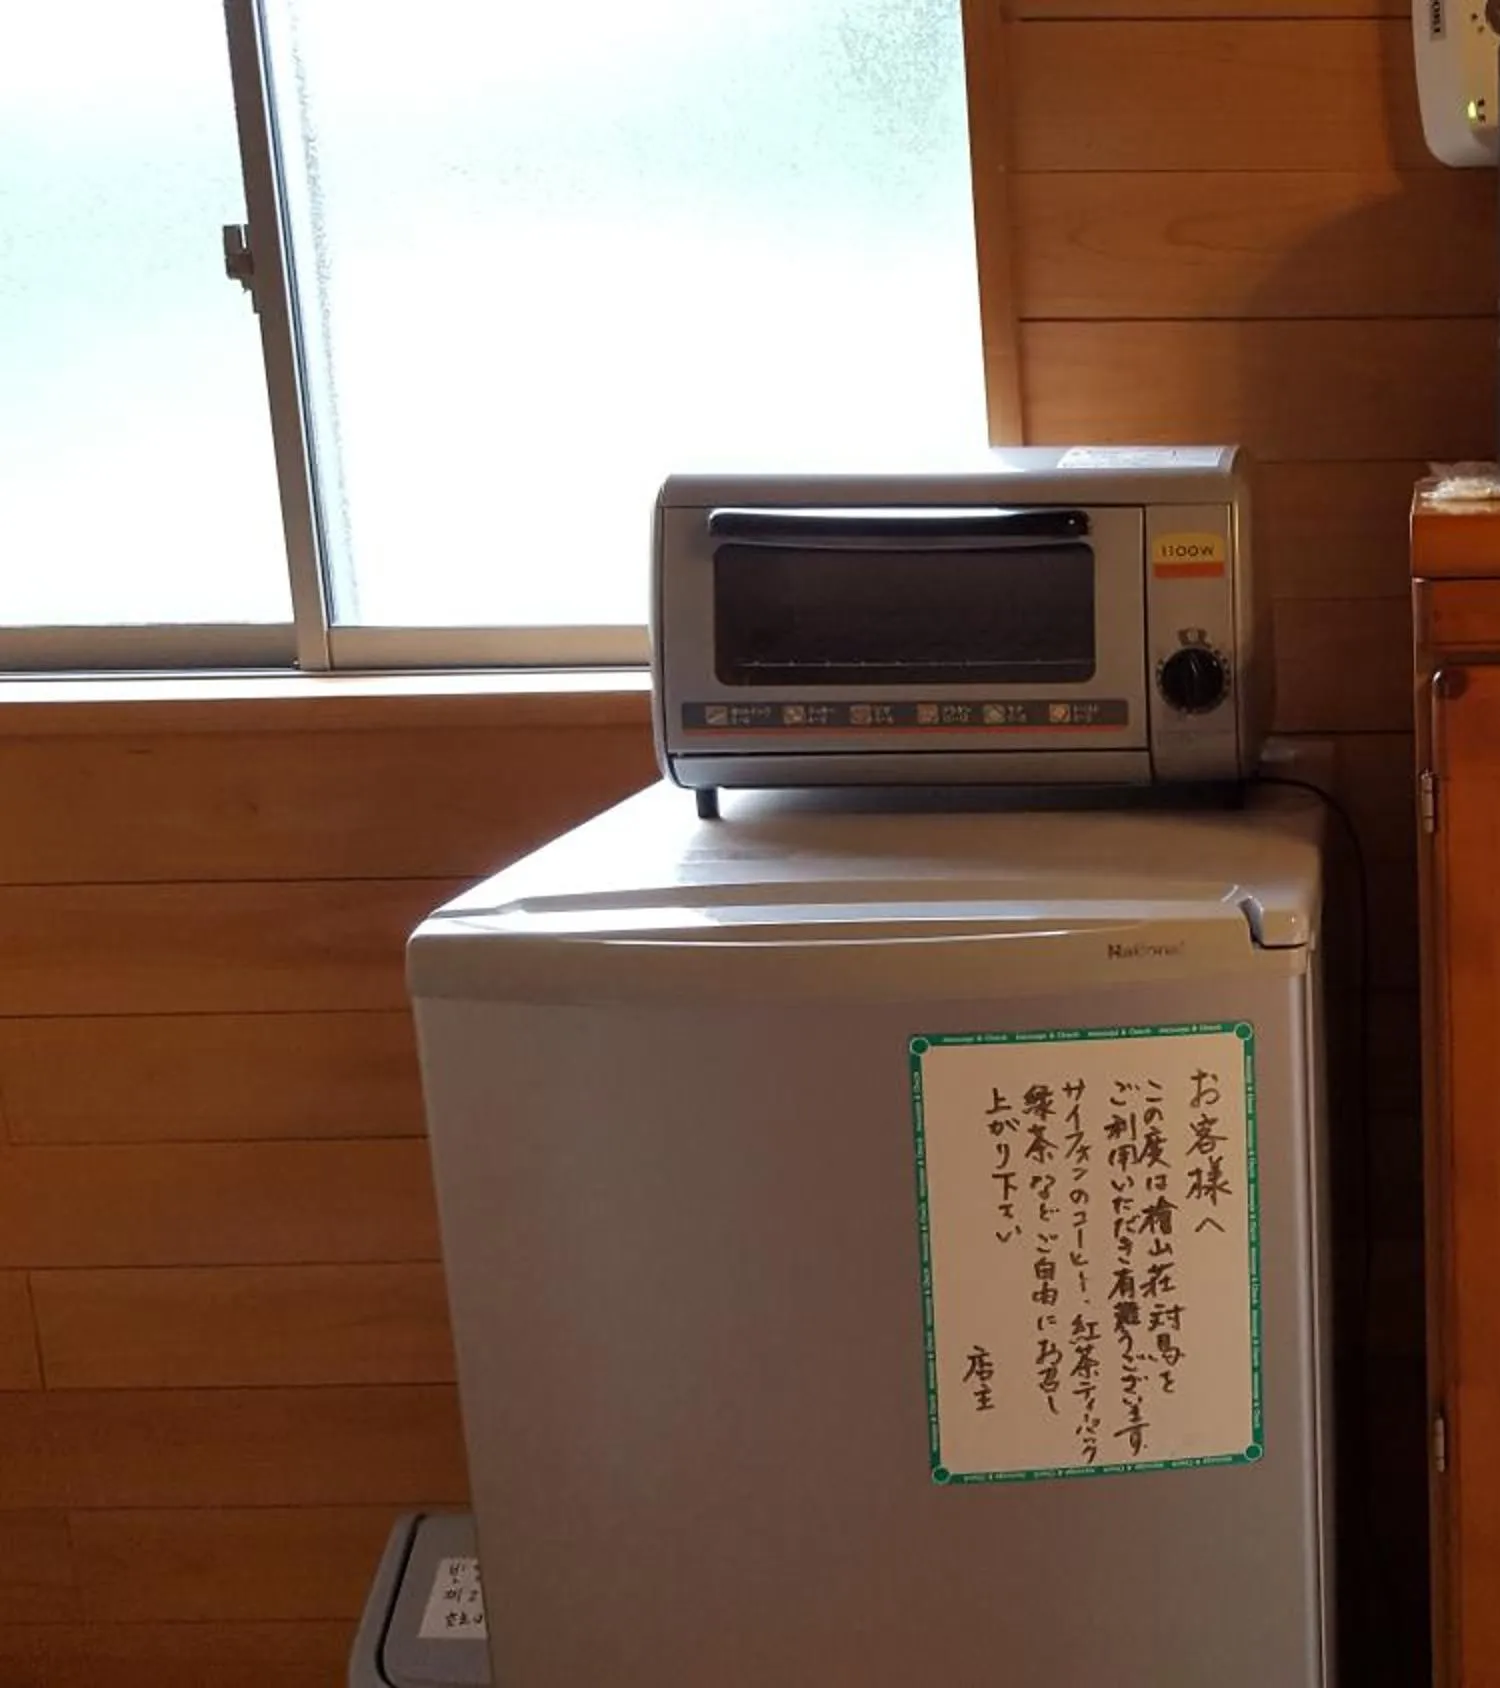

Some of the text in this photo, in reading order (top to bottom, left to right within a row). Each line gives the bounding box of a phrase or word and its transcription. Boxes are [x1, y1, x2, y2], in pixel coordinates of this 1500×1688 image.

[1160, 543, 1216, 558] 1100W
[985, 1087, 1022, 1243] 上がり下さい
[1185, 1068, 1233, 1232] お客様へ
[963, 1345, 995, 1411] 店主
